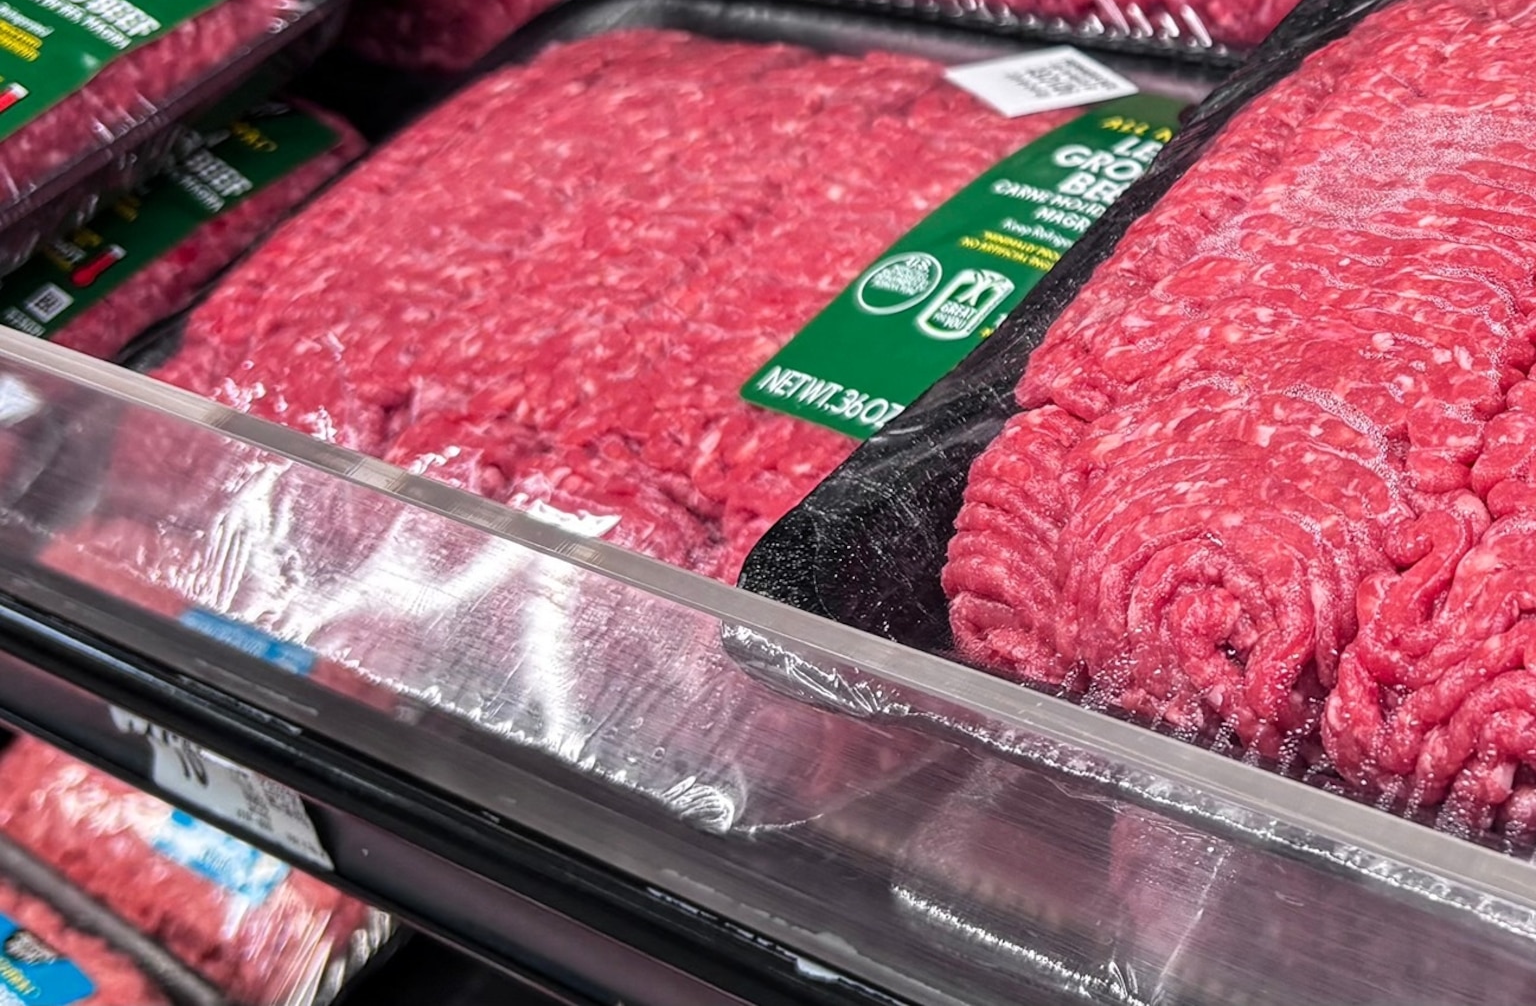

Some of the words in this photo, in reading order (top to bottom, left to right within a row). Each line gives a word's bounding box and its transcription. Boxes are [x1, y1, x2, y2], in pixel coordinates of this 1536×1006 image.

[1053, 144, 1145, 182] GRO
[1113, 135, 1165, 163] LE
[1057, 170, 1131, 205] BE
[1033, 205, 1092, 234] MAGR
[1050, 191, 1107, 220] MOLID
